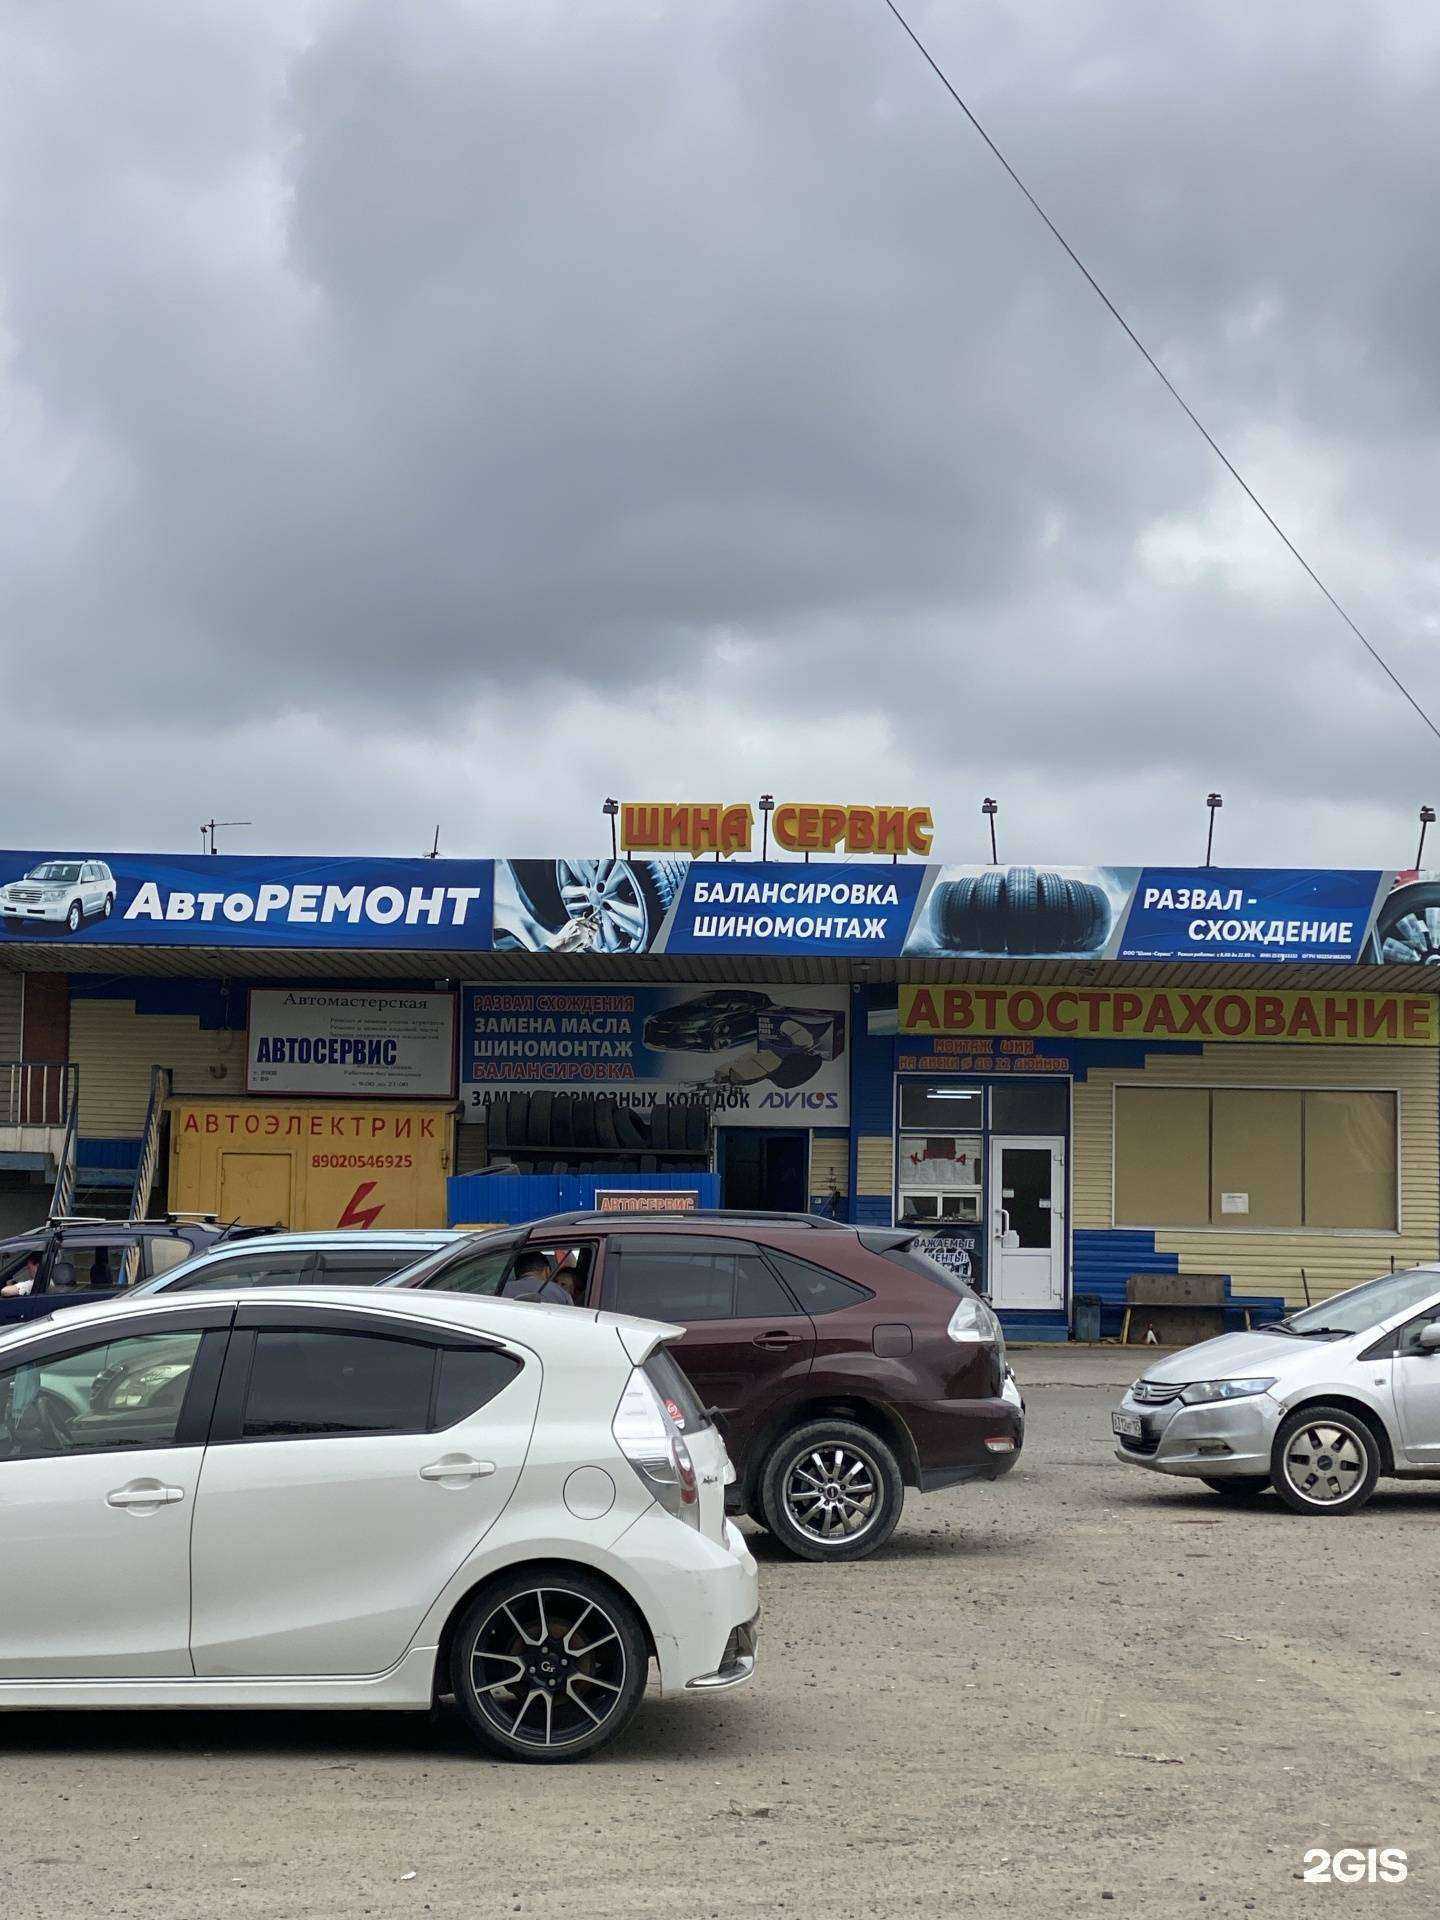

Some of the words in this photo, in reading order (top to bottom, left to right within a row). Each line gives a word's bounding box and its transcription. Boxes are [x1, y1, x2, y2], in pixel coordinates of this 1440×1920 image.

[623, 804, 752, 850] ШИНА
[774, 805, 933, 853] СЕРВИС
[693, 882, 899, 905] БАЛАНСИРОВКА
[692, 916, 887, 938] ШИНОМОНТАЖ
[1188, 919, 1353, 946] СХОЖДЕНИЕ
[283, 993, 429, 1012] Автомастерская
[473, 995, 534, 1012] РАЗВАЛ
[536, 995, 635, 1014] СХОЖДЕНИЯ
[905, 987, 1432, 1040] АВТОСТРАХОВАНИЕ
[474, 1017, 556, 1033] ЗАМЕНА
[561, 1018, 632, 1034] МАСЛА
[256, 1036, 398, 1066] АВТОСЕРВИС
[474, 1040, 634, 1057] ШИНОМОНТАЖ
[472, 1062, 636, 1080] БАЛАНСИРОВКА
[184, 1114, 435, 1138] АВТОЭЛЕКТРИК
[312, 1154, 413, 1169] 89020546925
[913, 1237, 976, 1250] ВАЖАЕМЫЕ
